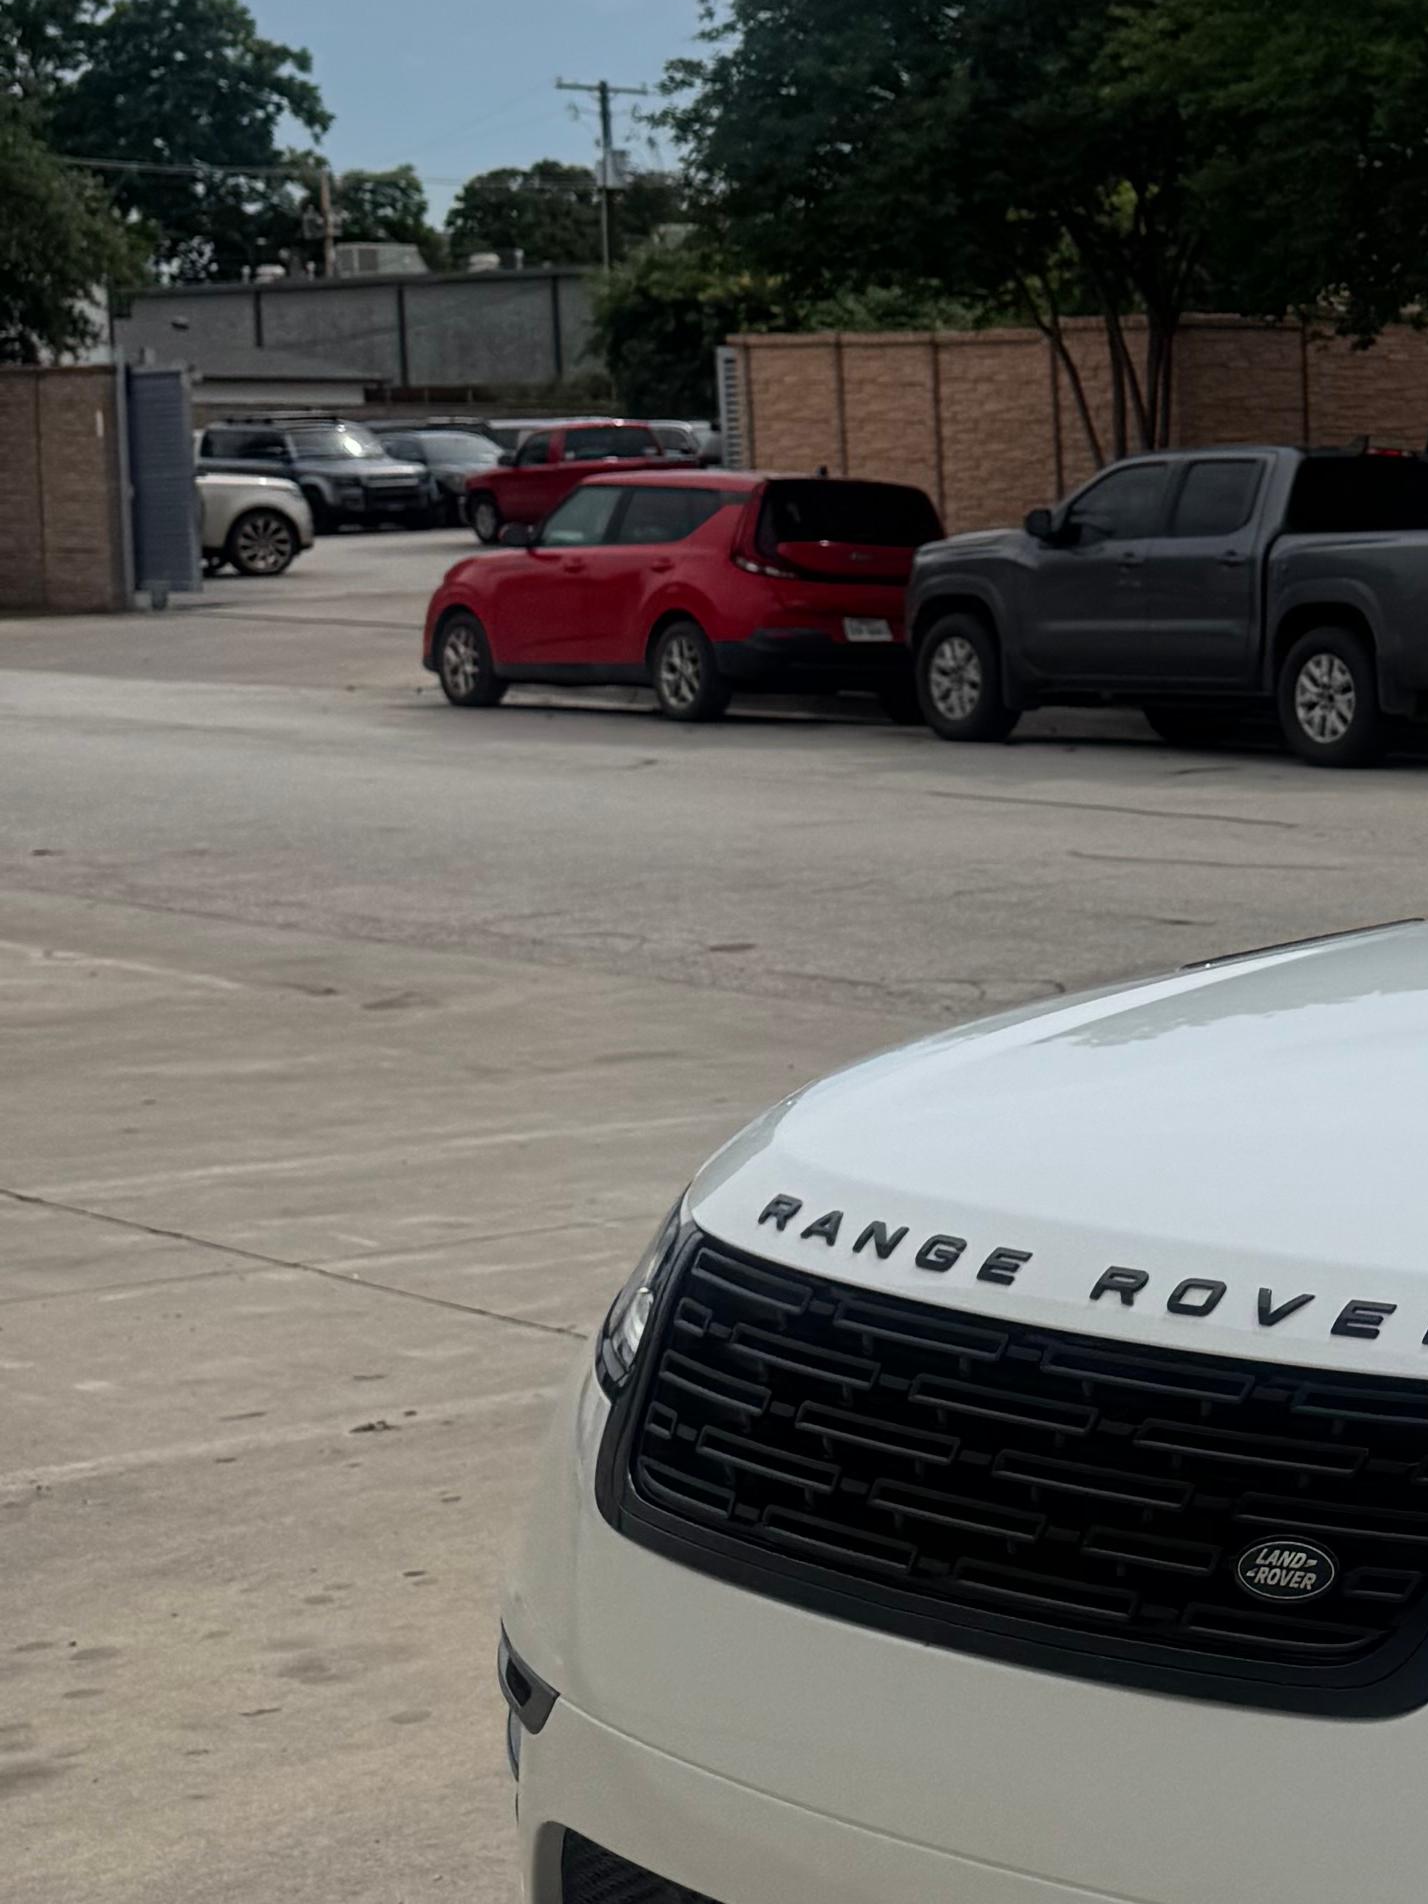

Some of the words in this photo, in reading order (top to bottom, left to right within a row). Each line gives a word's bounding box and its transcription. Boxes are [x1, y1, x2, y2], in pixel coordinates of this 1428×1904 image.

[757, 1193, 1034, 1286] RANGE
[1255, 1548, 1308, 1569] LAND
[1253, 1566, 1317, 1590] ROVER
